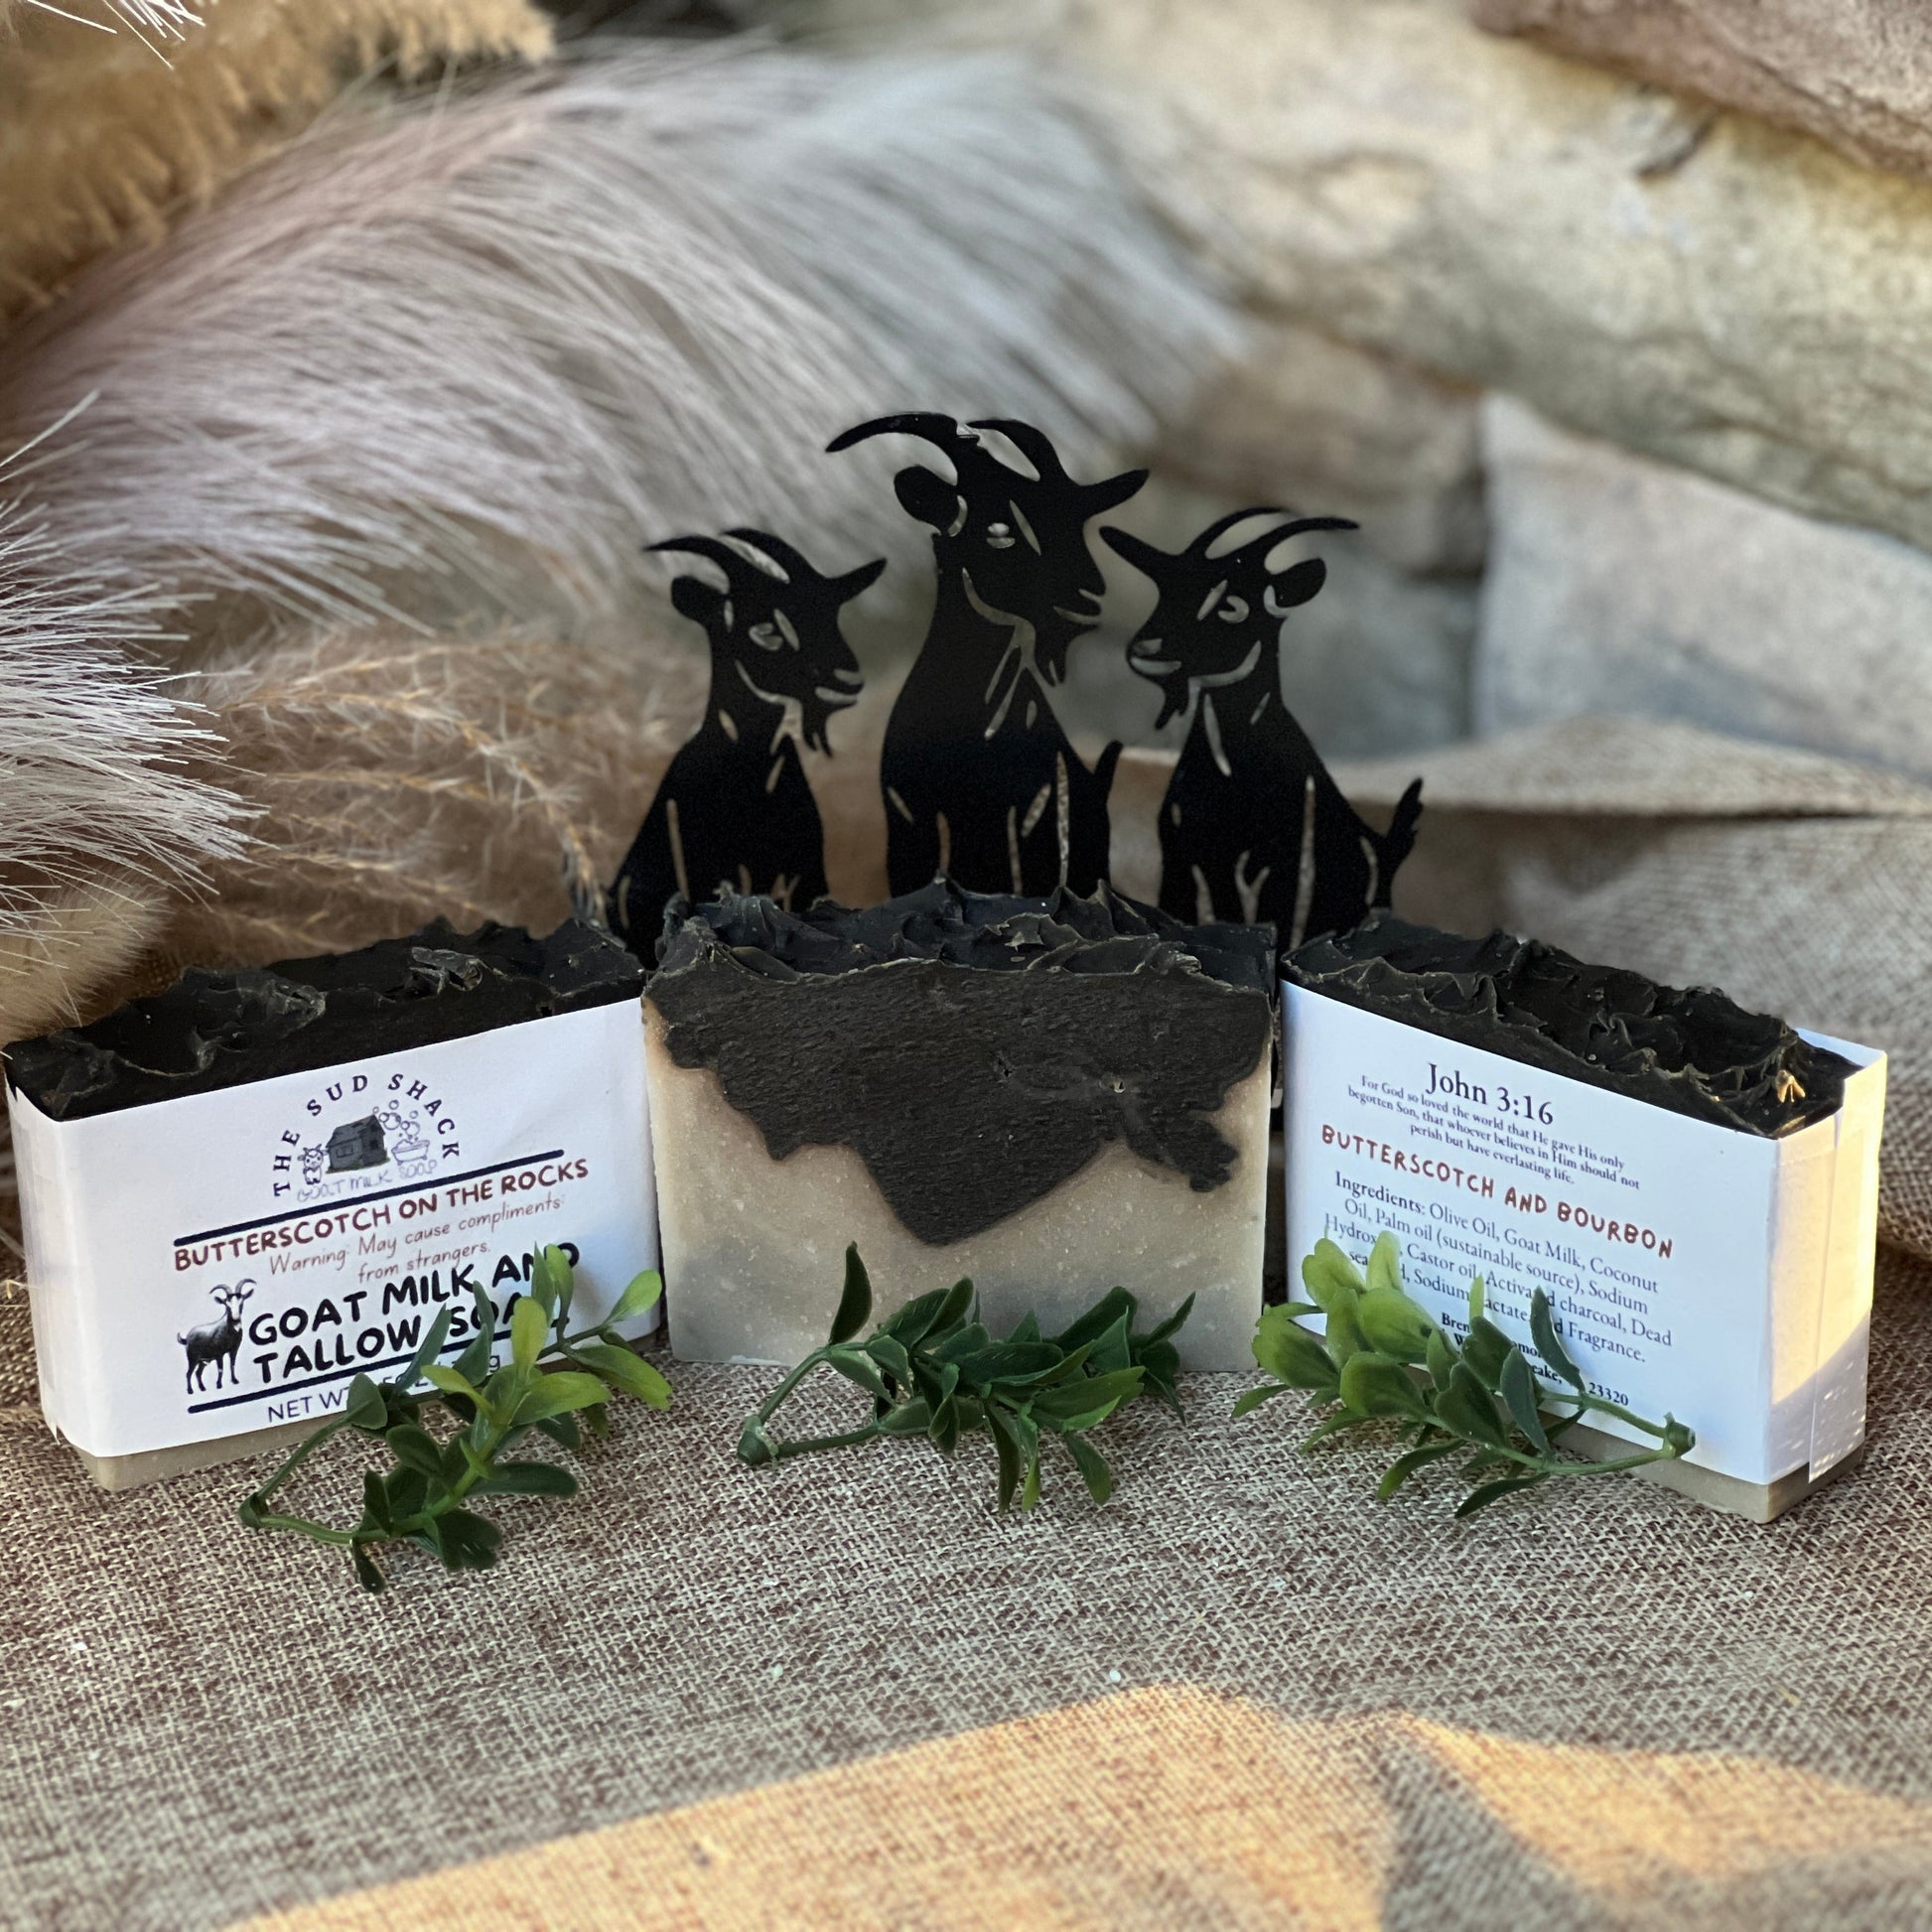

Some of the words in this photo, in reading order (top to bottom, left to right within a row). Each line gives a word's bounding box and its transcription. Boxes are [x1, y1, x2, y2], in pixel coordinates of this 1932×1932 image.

[273, 1130, 300, 1196] THE
[307, 1075, 367, 1116] SUD
[388, 1073, 460, 1159] SHACK
[1348, 1085, 1394, 1110] begotten
[1396, 1102, 1420, 1121] Son,
[1423, 1111, 1444, 1127] that
[1448, 1119, 1491, 1141] whoever
[1494, 1132, 1535, 1156] believes
[1538, 1148, 1549, 1160] in
[1552, 1150, 1577, 1170] Him
[1581, 1162, 1617, 1182] should
[1621, 1176, 1640, 1189] not
[1361, 1074, 1378, 1090] For
[1381, 1082, 1404, 1099] God
[1407, 1094, 1419, 1103] so
[1422, 1094, 1449, 1113] loved
[1452, 1106, 1470, 1120] the
[1472, 1113, 1503, 1131] world
[1508, 1123, 1529, 1139] that
[1533, 1130, 1549, 1146] He
[1552, 1139, 1575, 1154] gave
[1579, 1145, 1597, 1161] His
[1600, 1155, 1625, 1173] only
[1425, 1062, 1487, 1104] John
[1497, 1086, 1554, 1125] 3:16
[1321, 1124, 1494, 1198] BUTTERSCOTCH
[1504, 1186, 1547, 1213] AND
[1557, 1201, 1673, 1259] BOURBON
[1410, 1124, 1442, 1141] perish
[1446, 1131, 1463, 1149] but
[1467, 1140, 1490, 1157] have
[1493, 1152, 1551, 1179] everlasting
[1554, 1168, 1575, 1183] life.
[175, 1203, 391, 1271] BUTTERSCOTCH
[399, 1193, 437, 1219] ON
[446, 1179, 493, 1207] THE
[501, 1159, 588, 1194] ROCKS
[358, 1233, 396, 1259] May
[405, 1223, 451, 1245] cause
[1335, 1171, 1426, 1215] Ingredients:
[1430, 1202, 1468, 1230] Olive
[1472, 1217, 1500, 1242] Oil,
[1504, 1228, 1541, 1255] Goat
[1545, 1241, 1586, 1271] Milk,
[1589, 1257, 1658, 1294] Coconut
[1344, 1197, 1371, 1223] Oil,
[1376, 1207, 1411, 1234] Palm
[1414, 1224, 1433, 1242] oil
[1437, 1227, 1522, 1272] (sustainable
[1526, 1262, 1585, 1296] source),
[1588, 1279, 1648, 1314] Sodium
[249, 1291, 367, 1345] GOAT
[382, 1264, 475, 1314] MILK
[358, 1264, 399, 1284] from
[407, 1242, 490, 1272] strangers.
[1407, 1243, 1455, 1273] Castor
[1485, 1271, 1555, 1307] Activad
[1560, 1297, 1627, 1333] charcoal,
[1631, 1317, 1673, 1346] Dead
[254, 1314, 422, 1383] TALLOW
[1414, 1268, 1470, 1302] Sodium
[1478, 1295, 1529, 1321] actate
[1569, 1321, 1646, 1362] Fragrance.
[268, 1396, 313, 1423] NET
[1588, 1381, 1629, 1406] 23320
